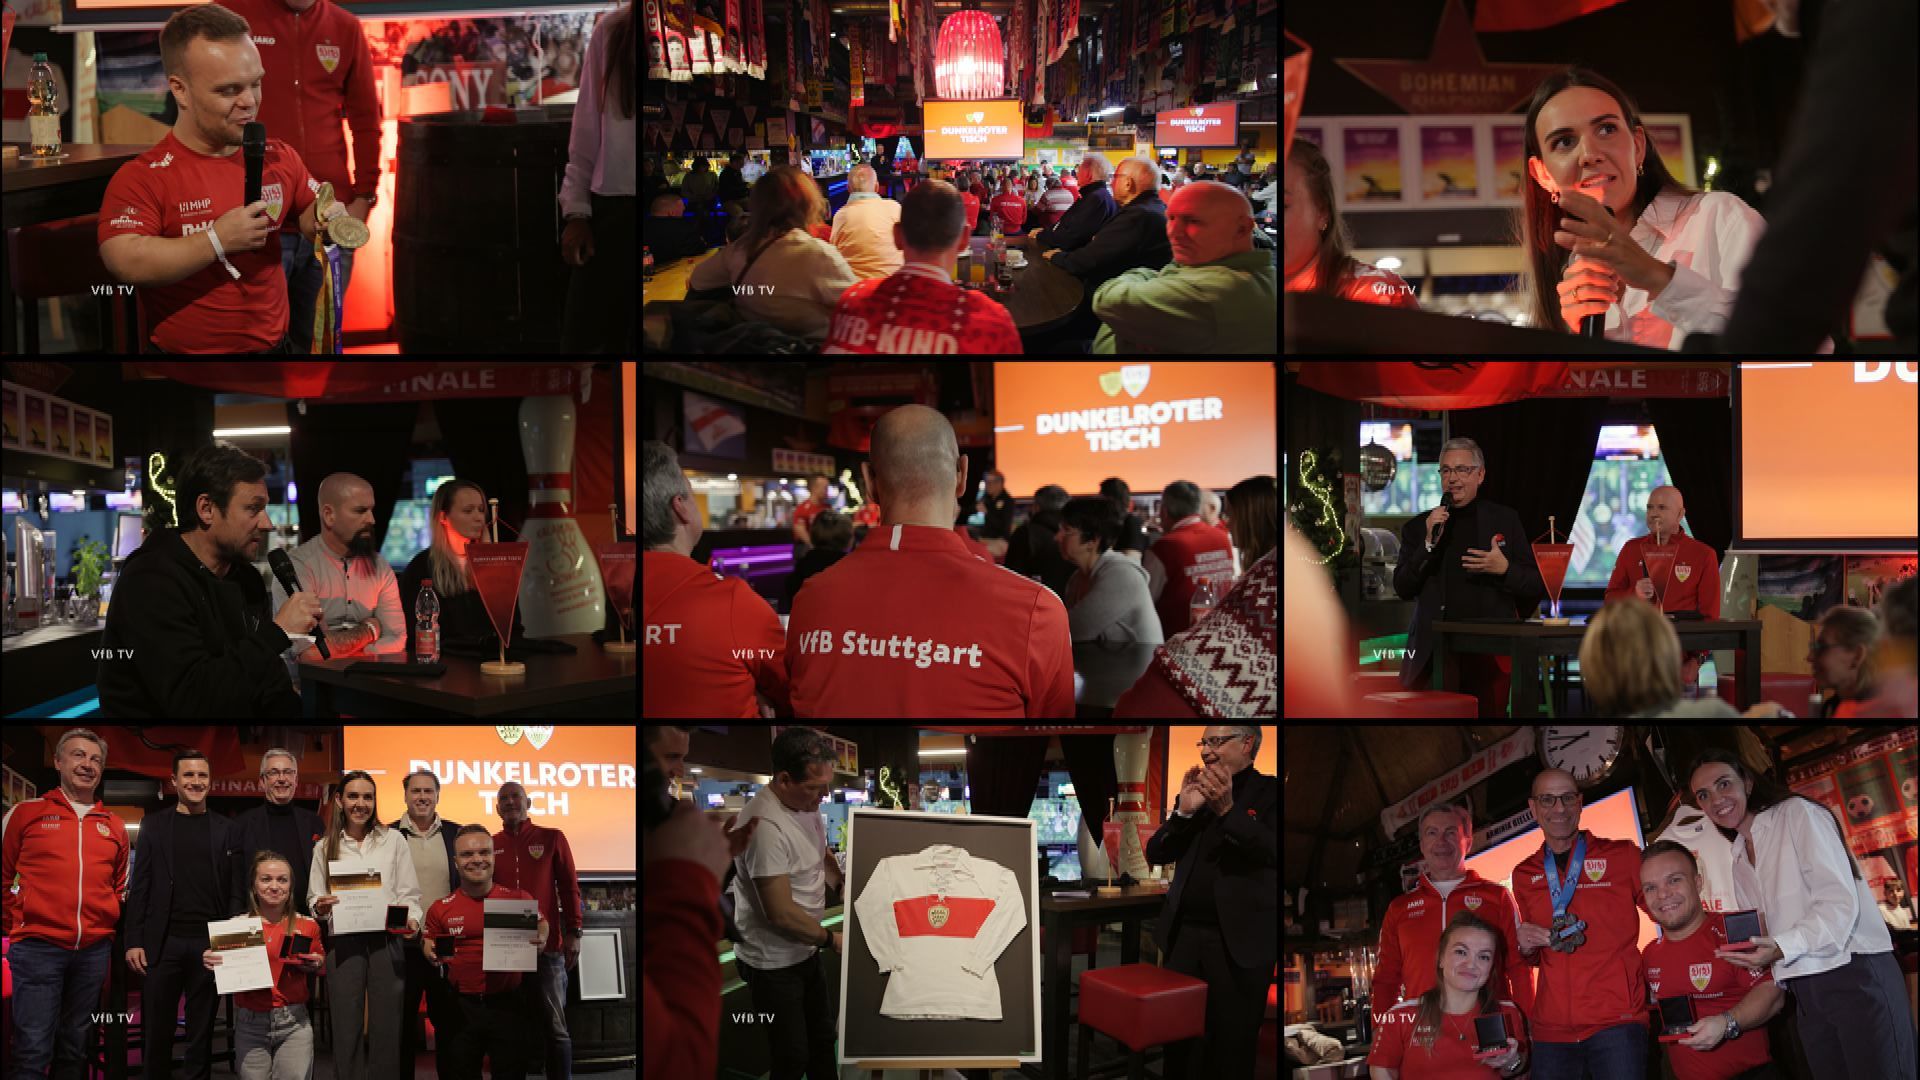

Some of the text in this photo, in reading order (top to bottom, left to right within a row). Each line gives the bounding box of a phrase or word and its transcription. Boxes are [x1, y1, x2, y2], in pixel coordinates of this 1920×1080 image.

[1401, 72, 1517, 92] BOHEMIAN
[1564, 368, 1648, 390] NALE
[1036, 396, 1223, 435] DUNKELROTER
[1085, 425, 1161, 453] TISCH
[799, 629, 982, 669] VfB Stuttgart
[409, 759, 636, 788] DUNKELROTER
[478, 790, 569, 816] TCH
